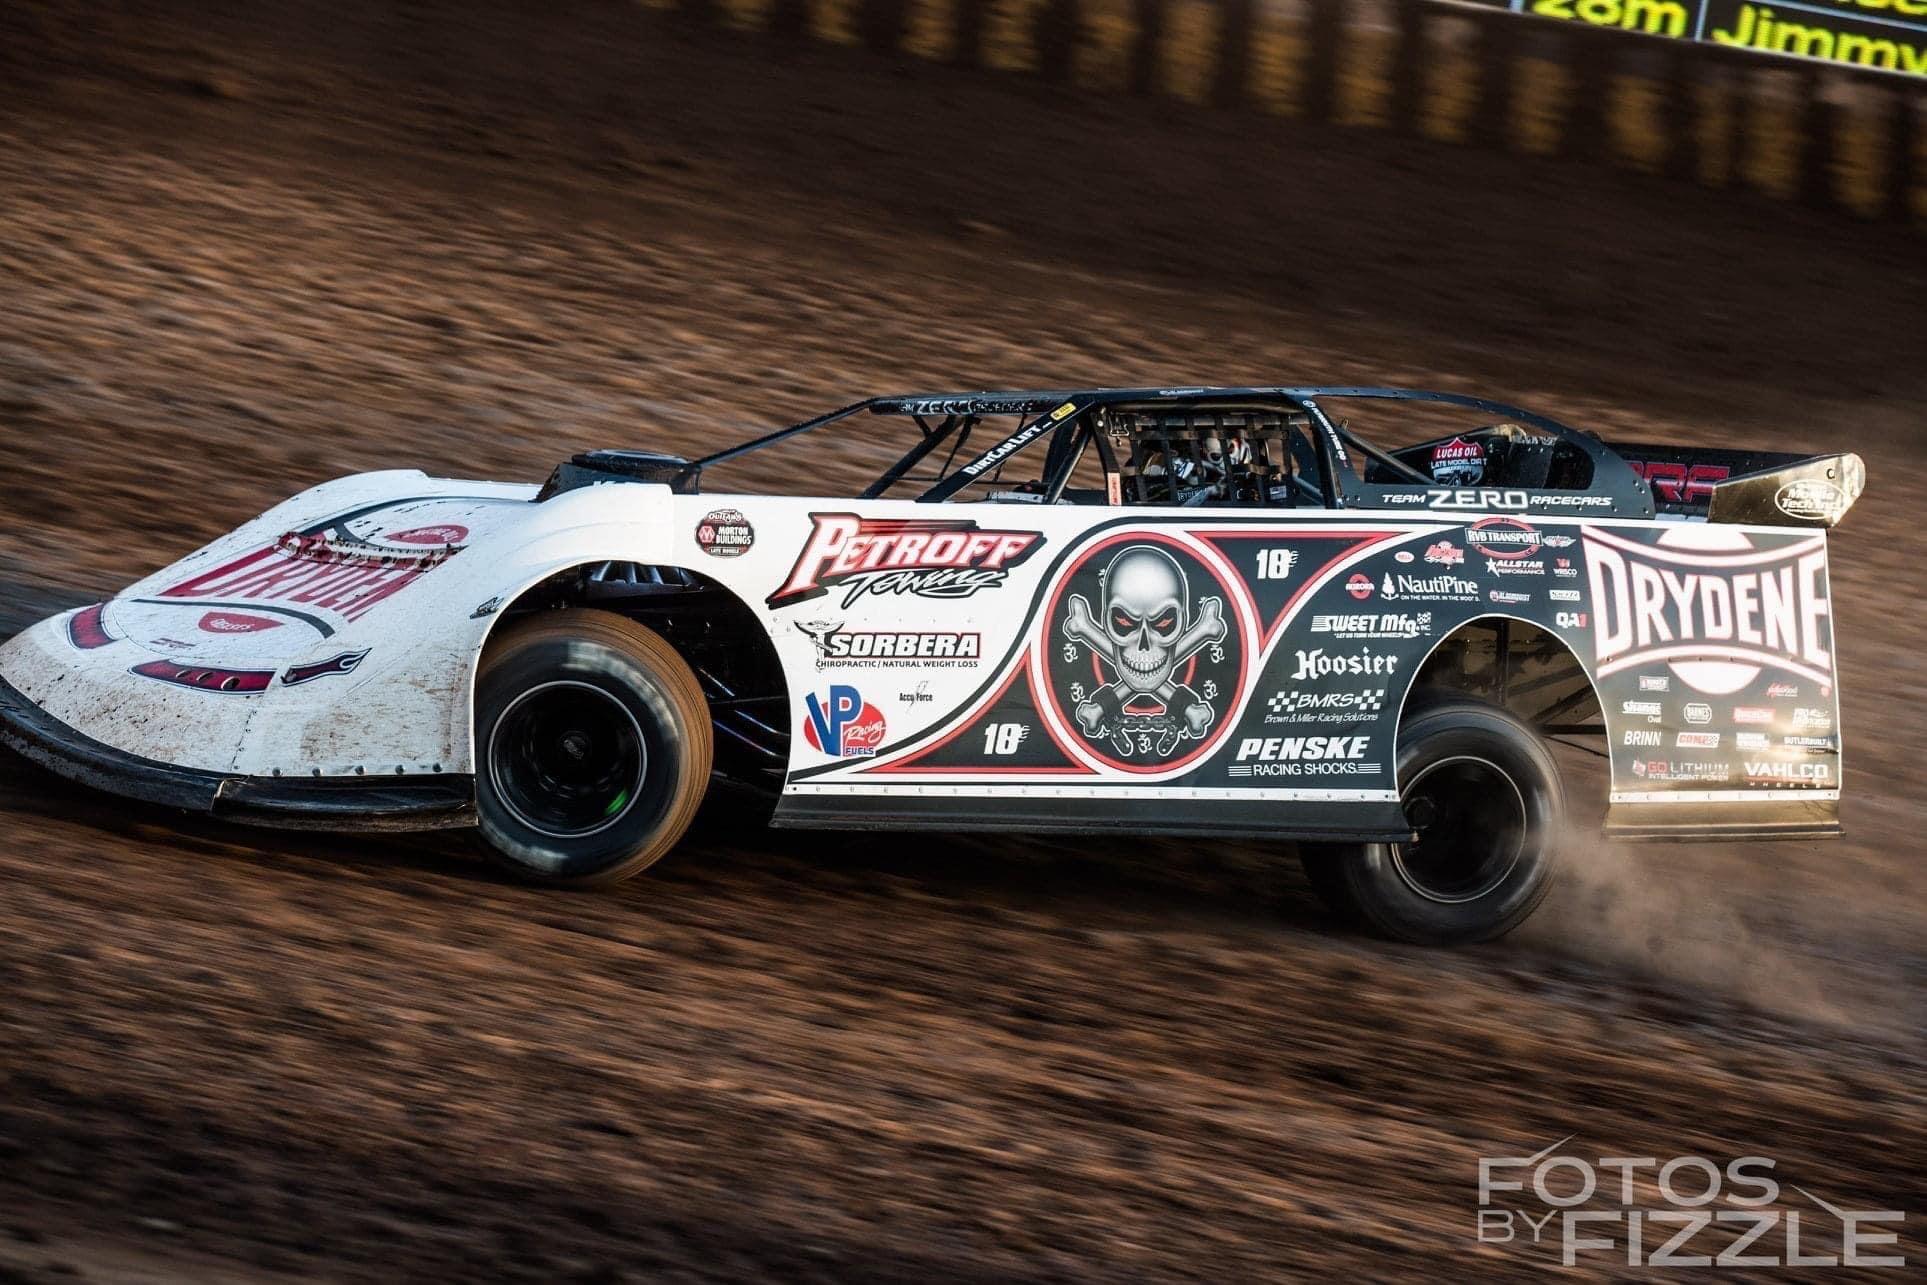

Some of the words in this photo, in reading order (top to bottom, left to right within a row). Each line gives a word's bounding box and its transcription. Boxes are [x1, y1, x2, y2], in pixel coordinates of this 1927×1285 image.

[1436, 447, 1463, 459] LUCAS
[1464, 446, 1478, 457] OIL
[1431, 459, 1447, 469] LATE
[1447, 458, 1470, 467] MODEL
[1382, 494, 1426, 504] TEAM
[1427, 490, 1530, 510] ZERO
[1529, 495, 1614, 507] RACECARS
[718, 526, 749, 536] MORTON
[1487, 531, 1540, 545] TRANSPORT
[715, 535, 753, 545] BUILDINGS
[769, 513, 1043, 602] PETROFF
[1495, 559, 1544, 569] ALLSTAR
[839, 567, 1009, 610] Towing
[1397, 574, 1478, 594] NautiPine
[1582, 535, 1832, 672] DRYDENE
[1311, 614, 1379, 633] SWEET
[1555, 612, 1587, 629] QA1
[830, 632, 981, 659] SORBERA
[816, 660, 877, 668] CHIROPRACTIC
[882, 660, 921, 668] NATURAL
[923, 660, 956, 668] WEIGHT
[957, 660, 979, 668] LOSS
[1290, 646, 1398, 680] Hoosier
[916, 692, 933, 702] Force
[1296, 693, 1354, 709] BMRS
[805, 684, 863, 757] VP
[1264, 714, 1289, 724] Brown
[1289, 714, 1296, 723] &
[1296, 713, 1317, 723] Miller
[1317, 713, 1343, 724] Racing
[1343, 712, 1379, 722] Solutions
[843, 720, 887, 745] Racing
[1623, 731, 1662, 746] BRINN
[845, 747, 875, 756] FUELS
[1236, 736, 1371, 761] PENSKE
[1253, 763, 1301, 776] RACING
[1670, 762, 1729, 774] LITHIUM
[1744, 762, 1829, 779] VAHLCO
